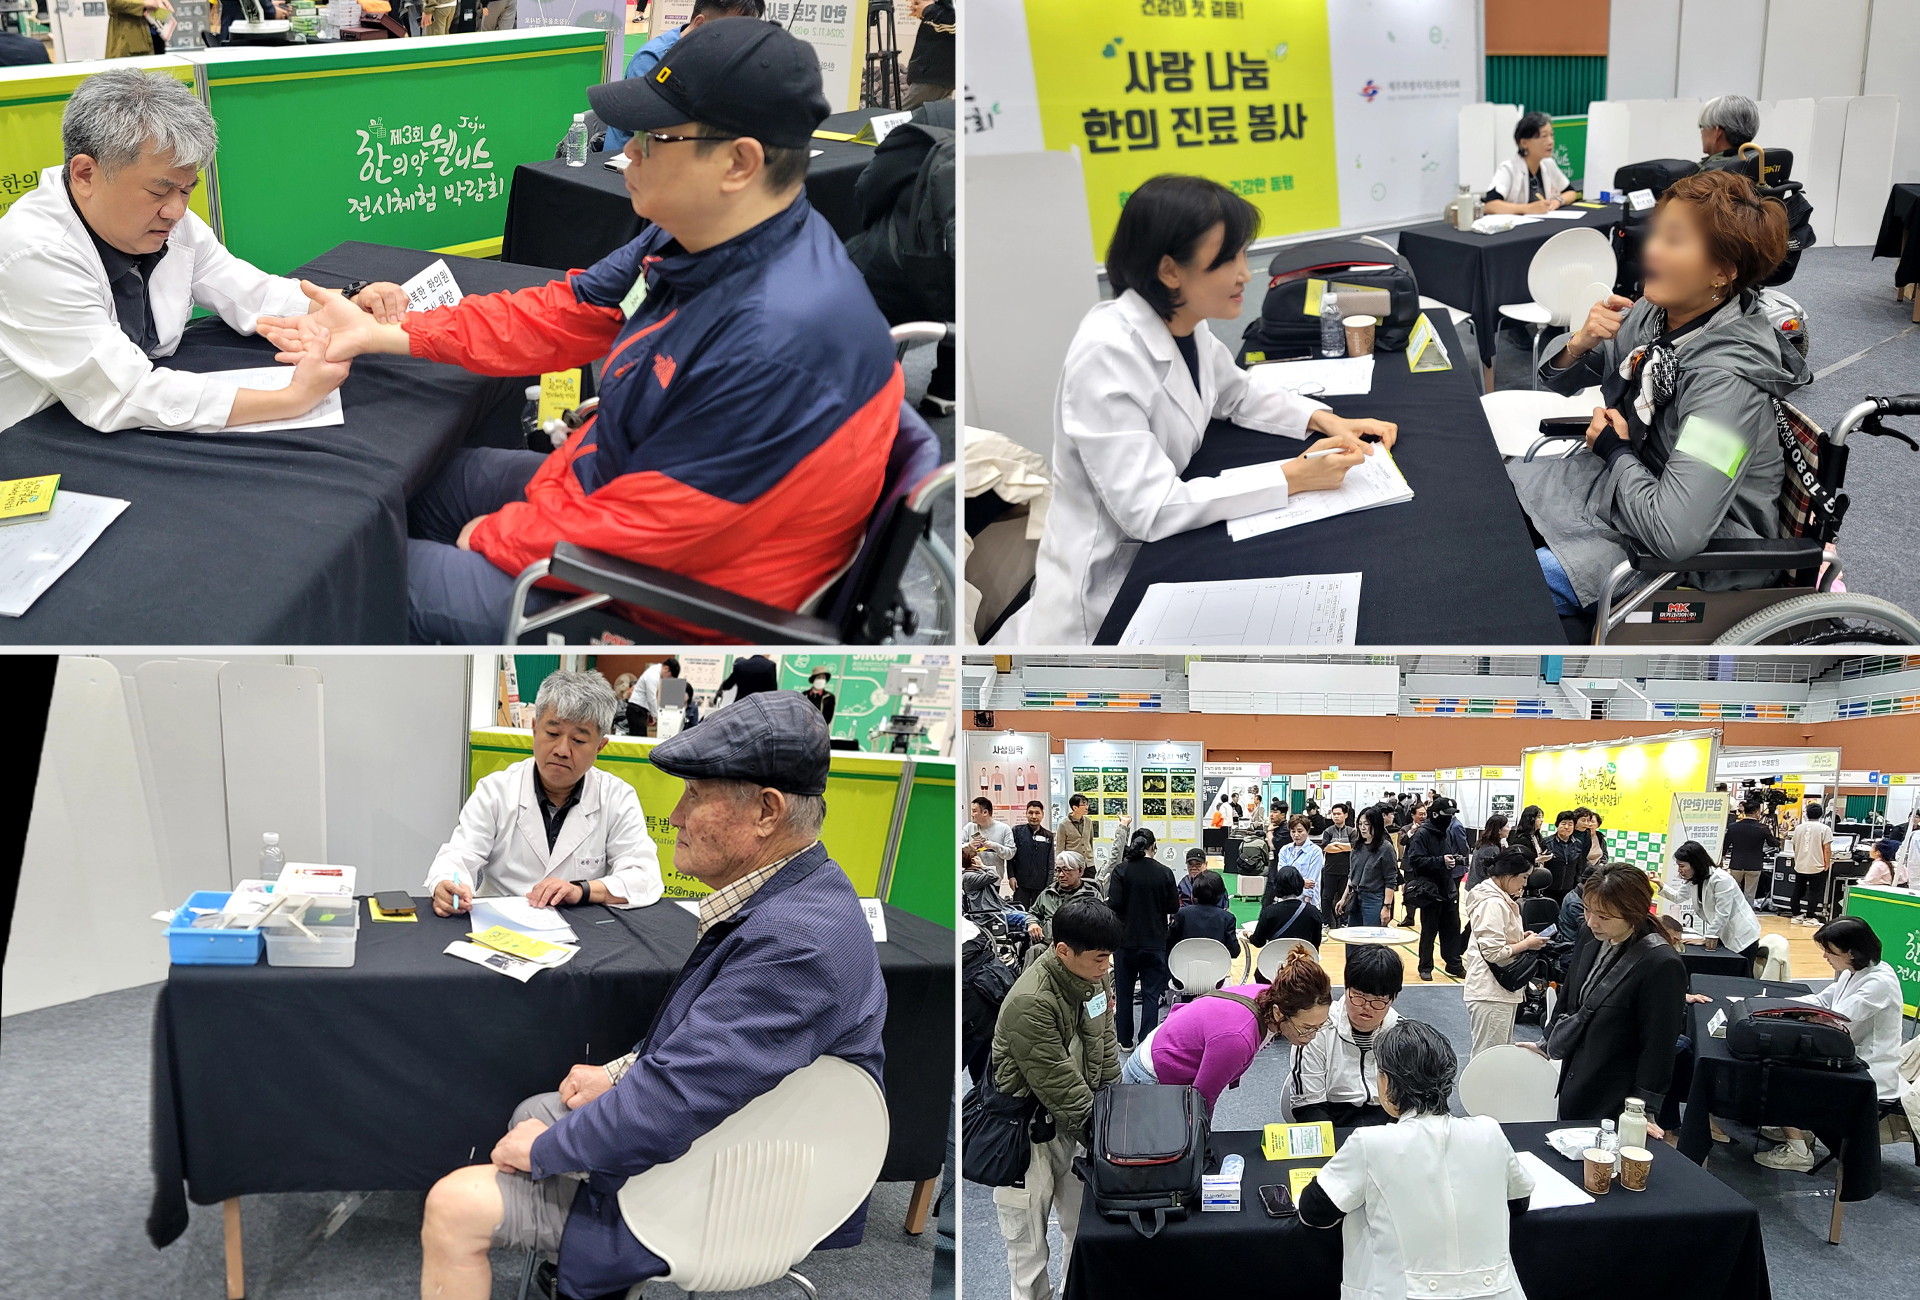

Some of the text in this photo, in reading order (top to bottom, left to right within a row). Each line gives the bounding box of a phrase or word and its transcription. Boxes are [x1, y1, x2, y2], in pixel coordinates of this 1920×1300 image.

[1125, 51, 1269, 94] 사랑 나눔
[390, 125, 424, 146] 제3회
[457, 115, 485, 134] Jeju
[1081, 103, 1308, 154] 한의 진료 봉사
[1271, 175, 1294, 191] 동행
[348, 172, 504, 222] 전시체험 박람회
[427, 270, 450, 293] 한의원
[1668, 603, 1690, 612] MK
